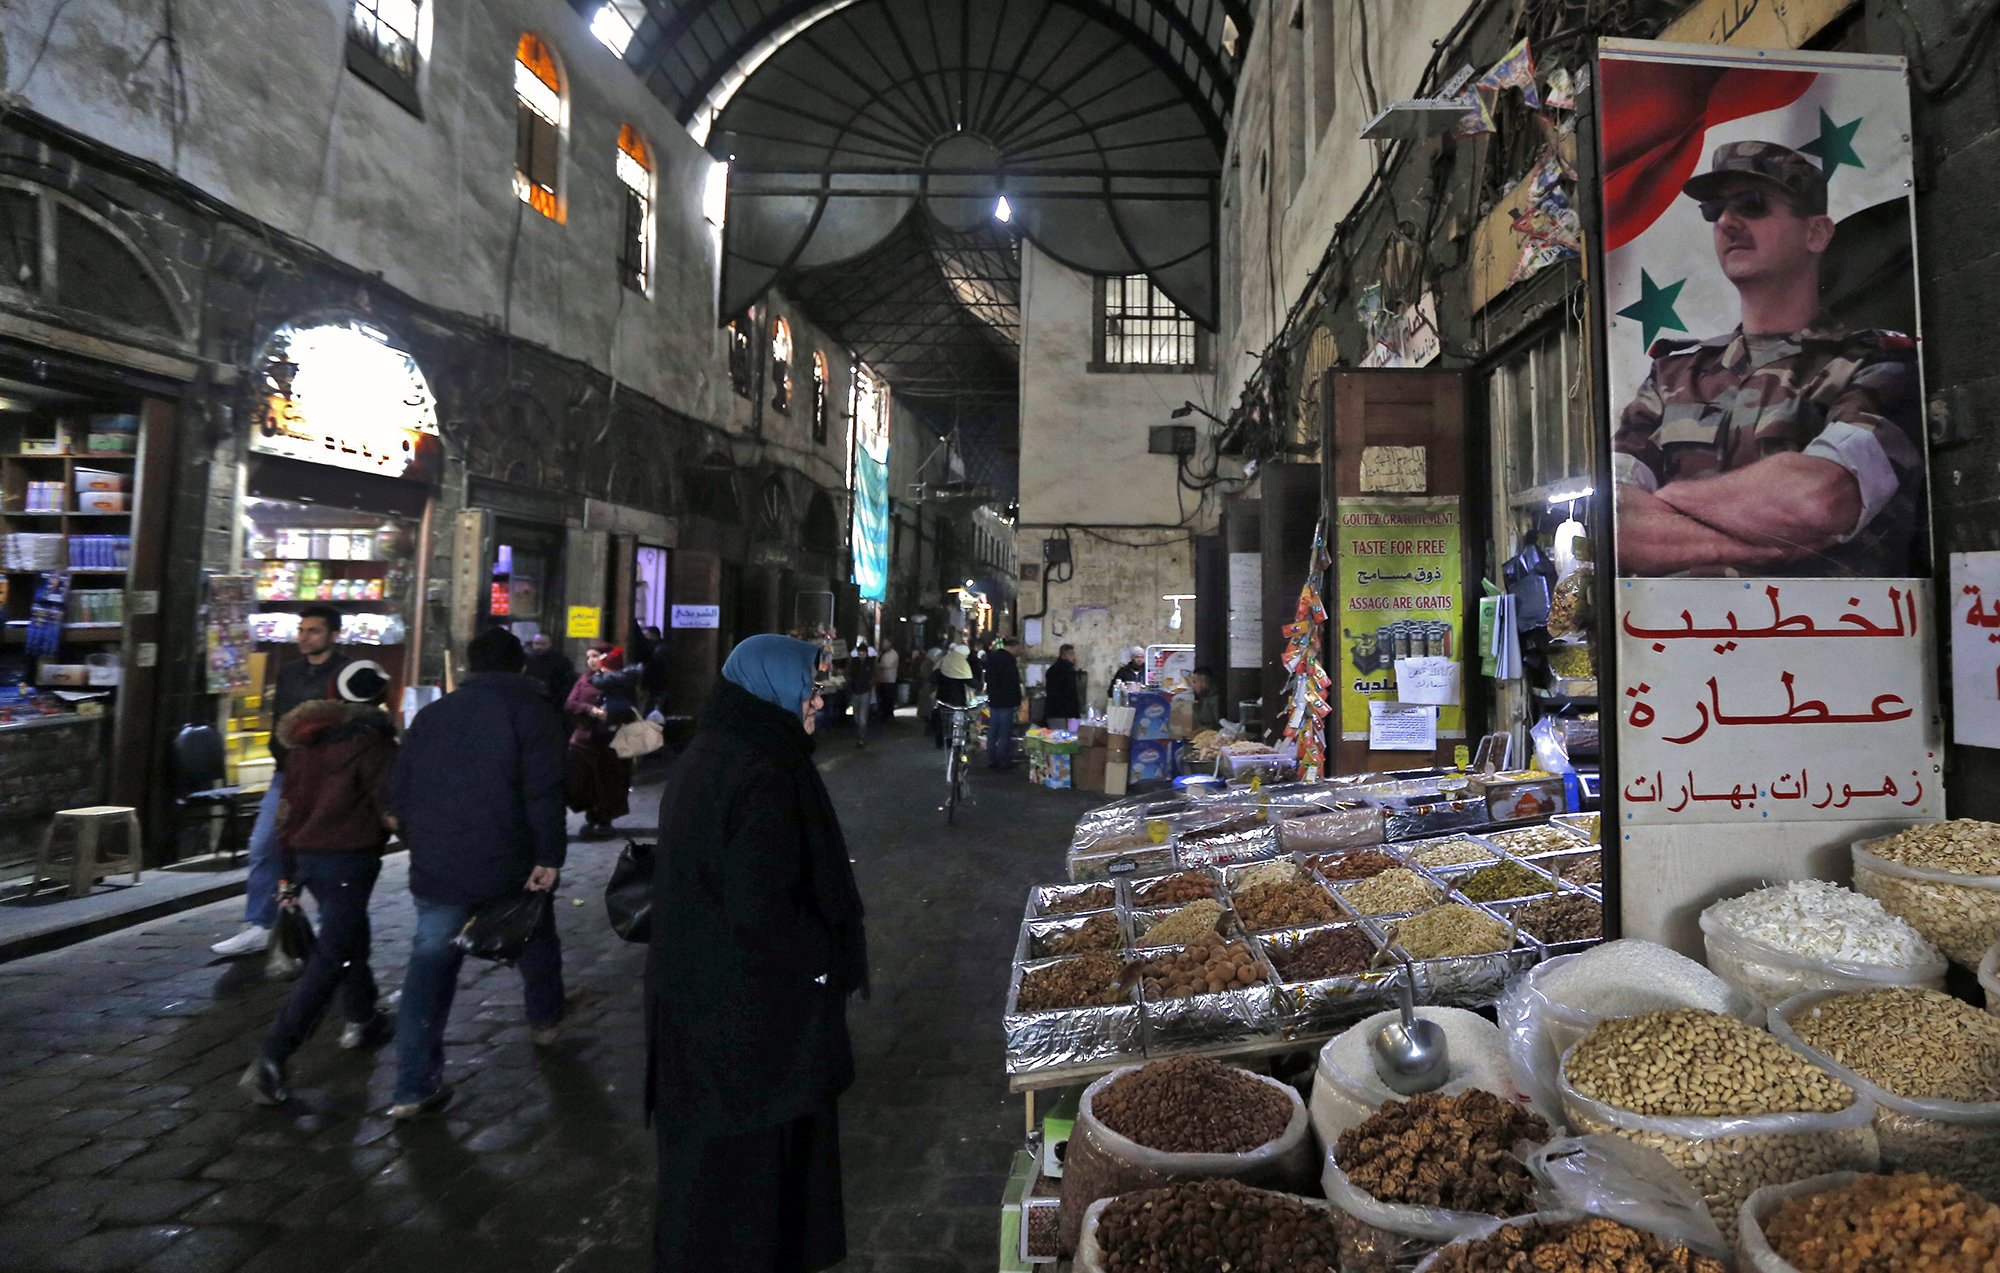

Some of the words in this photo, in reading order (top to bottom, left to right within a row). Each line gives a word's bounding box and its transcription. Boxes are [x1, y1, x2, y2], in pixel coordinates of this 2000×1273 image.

[1342, 513, 1381, 526] GOUTEZ
[1352, 540, 1387, 555] TASTE
[1390, 540, 1413, 555] FOR
[1417, 539, 1446, 554] FREE
[1414, 566, 1442, 583] ذوق
[1415, 595, 1452, 609] GRATIS
[1622, 584, 1917, 655] الخطيب
[1625, 670, 1914, 745] عطارة
[1623, 769, 1757, 813] بهارات
[1770, 768, 1923, 809] زهورات
